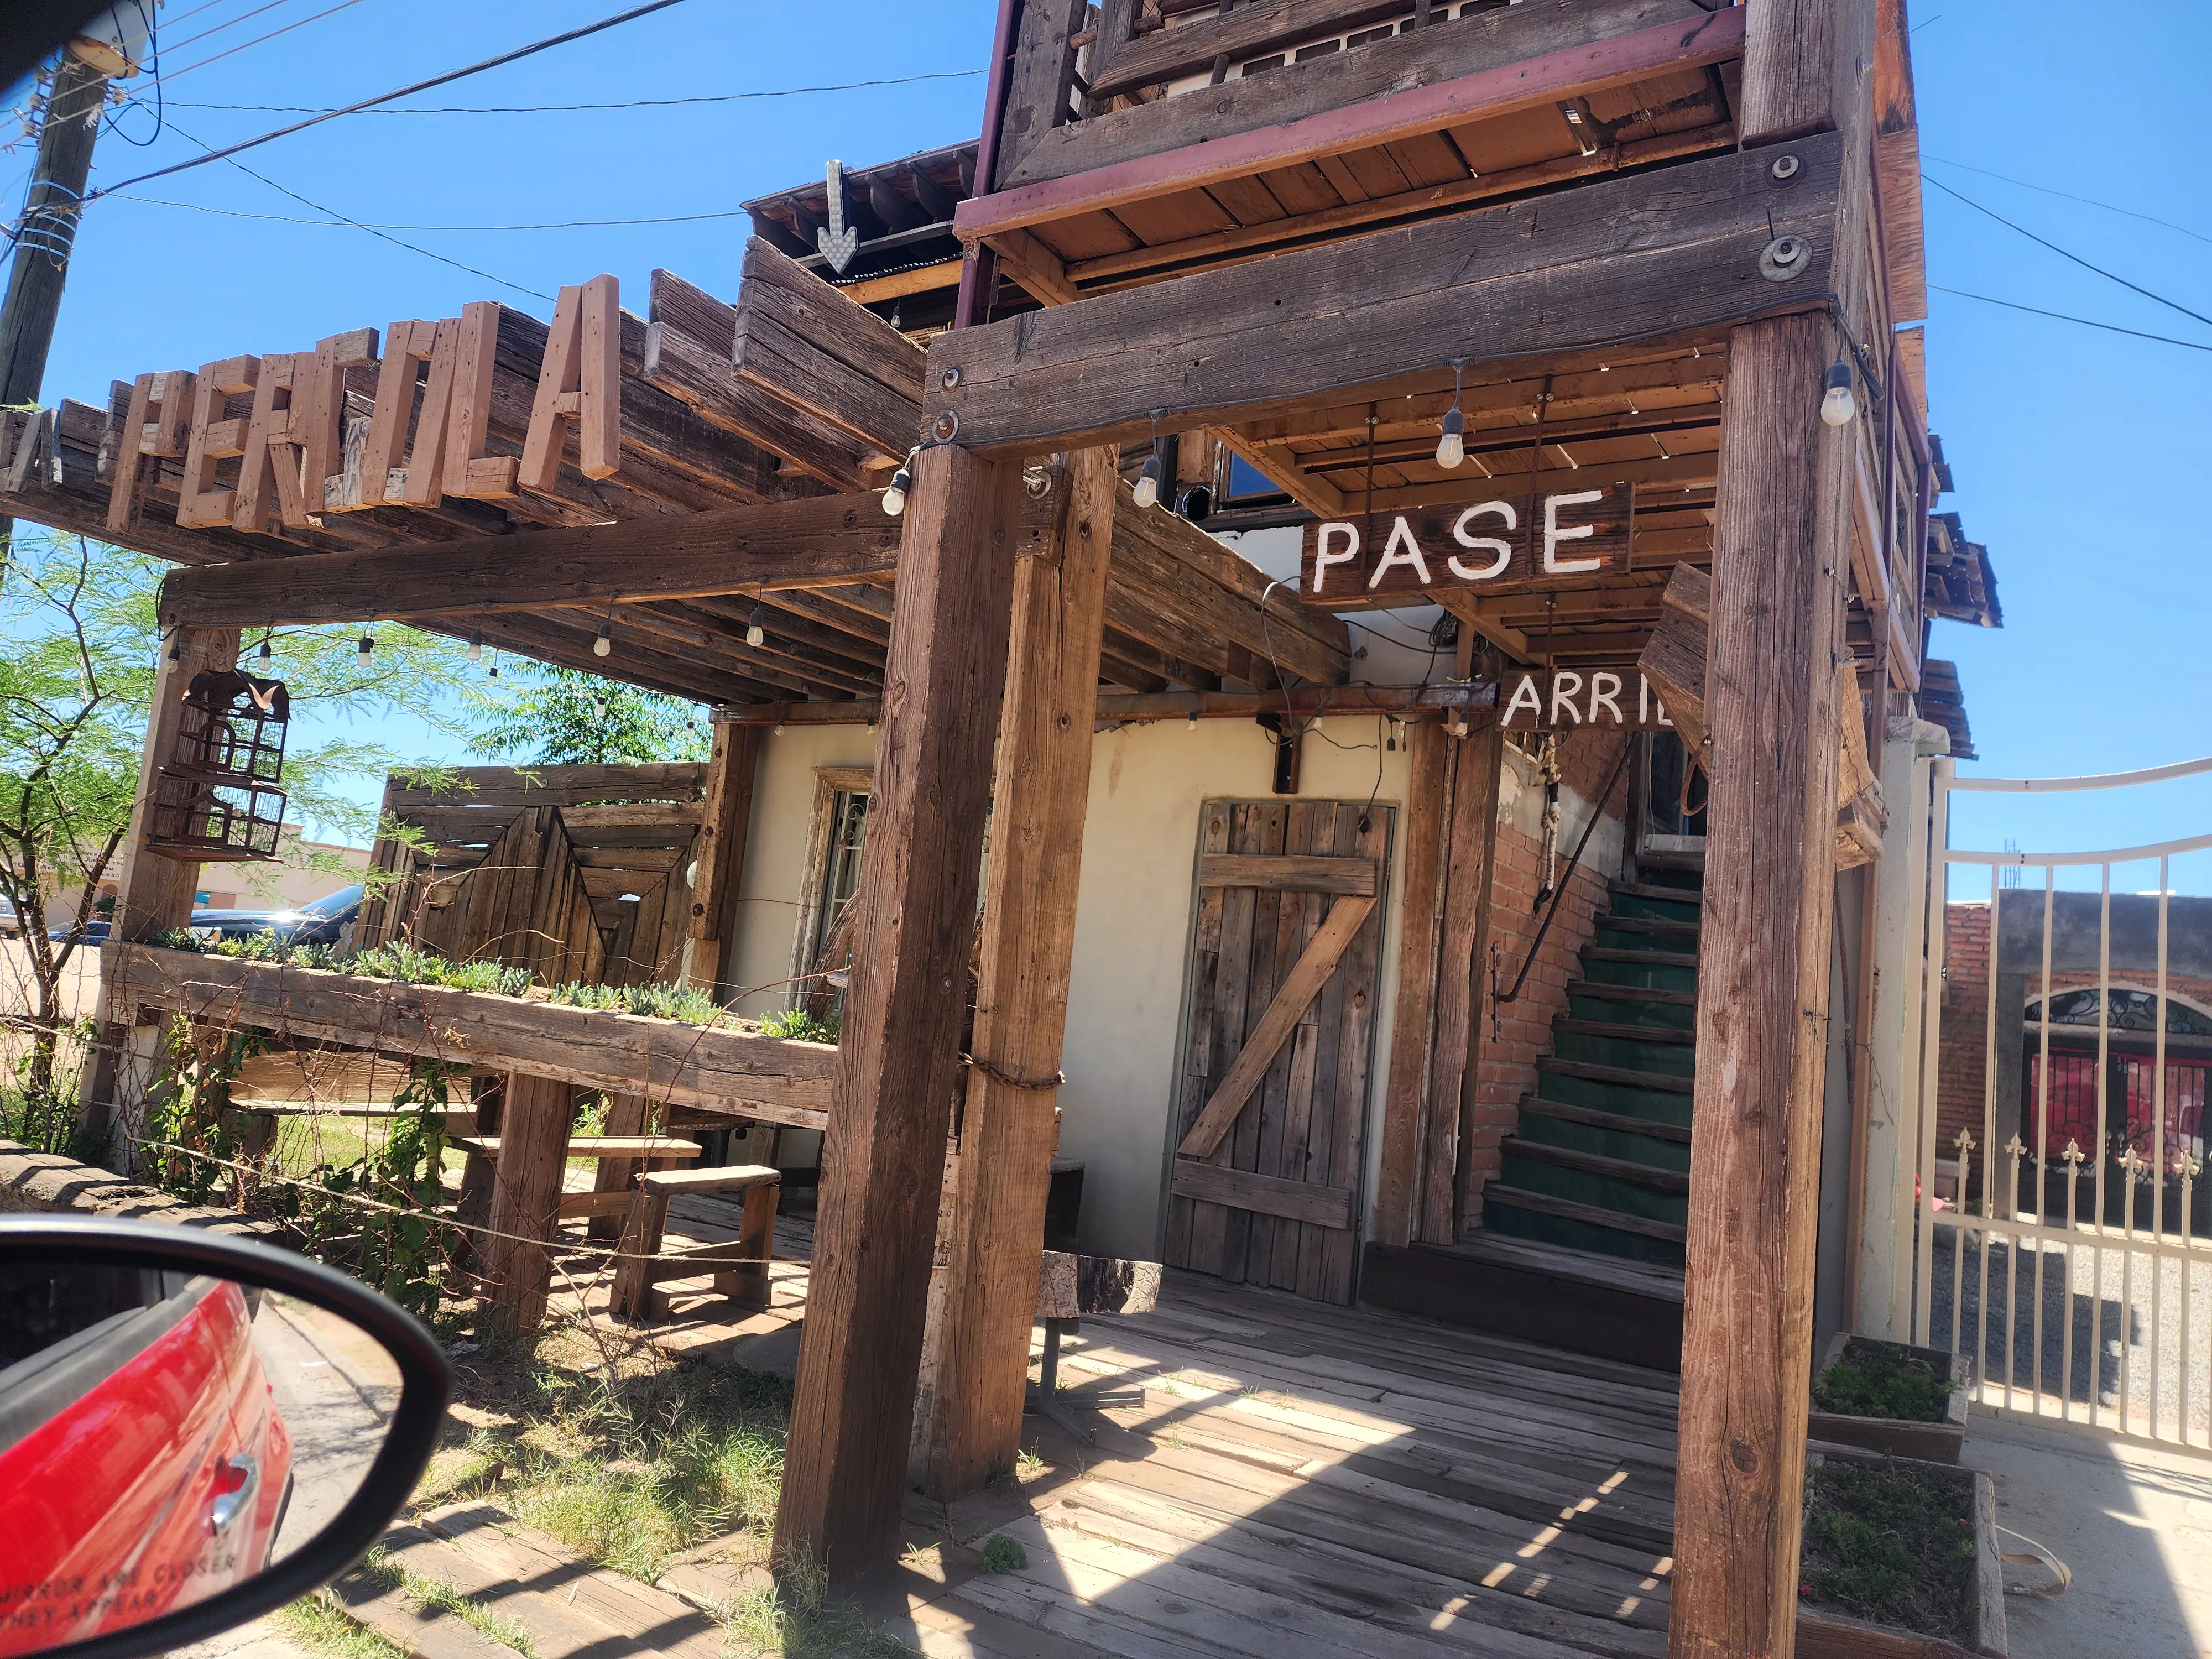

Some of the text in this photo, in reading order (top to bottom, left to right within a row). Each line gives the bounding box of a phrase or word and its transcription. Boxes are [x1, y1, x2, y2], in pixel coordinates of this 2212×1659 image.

[1313, 489, 1603, 593] PASE
[98, 1567, 140, 1591] ARE
[153, 1554, 236, 1585] CLOSER
[70, 1589, 157, 1618] APPEAR
